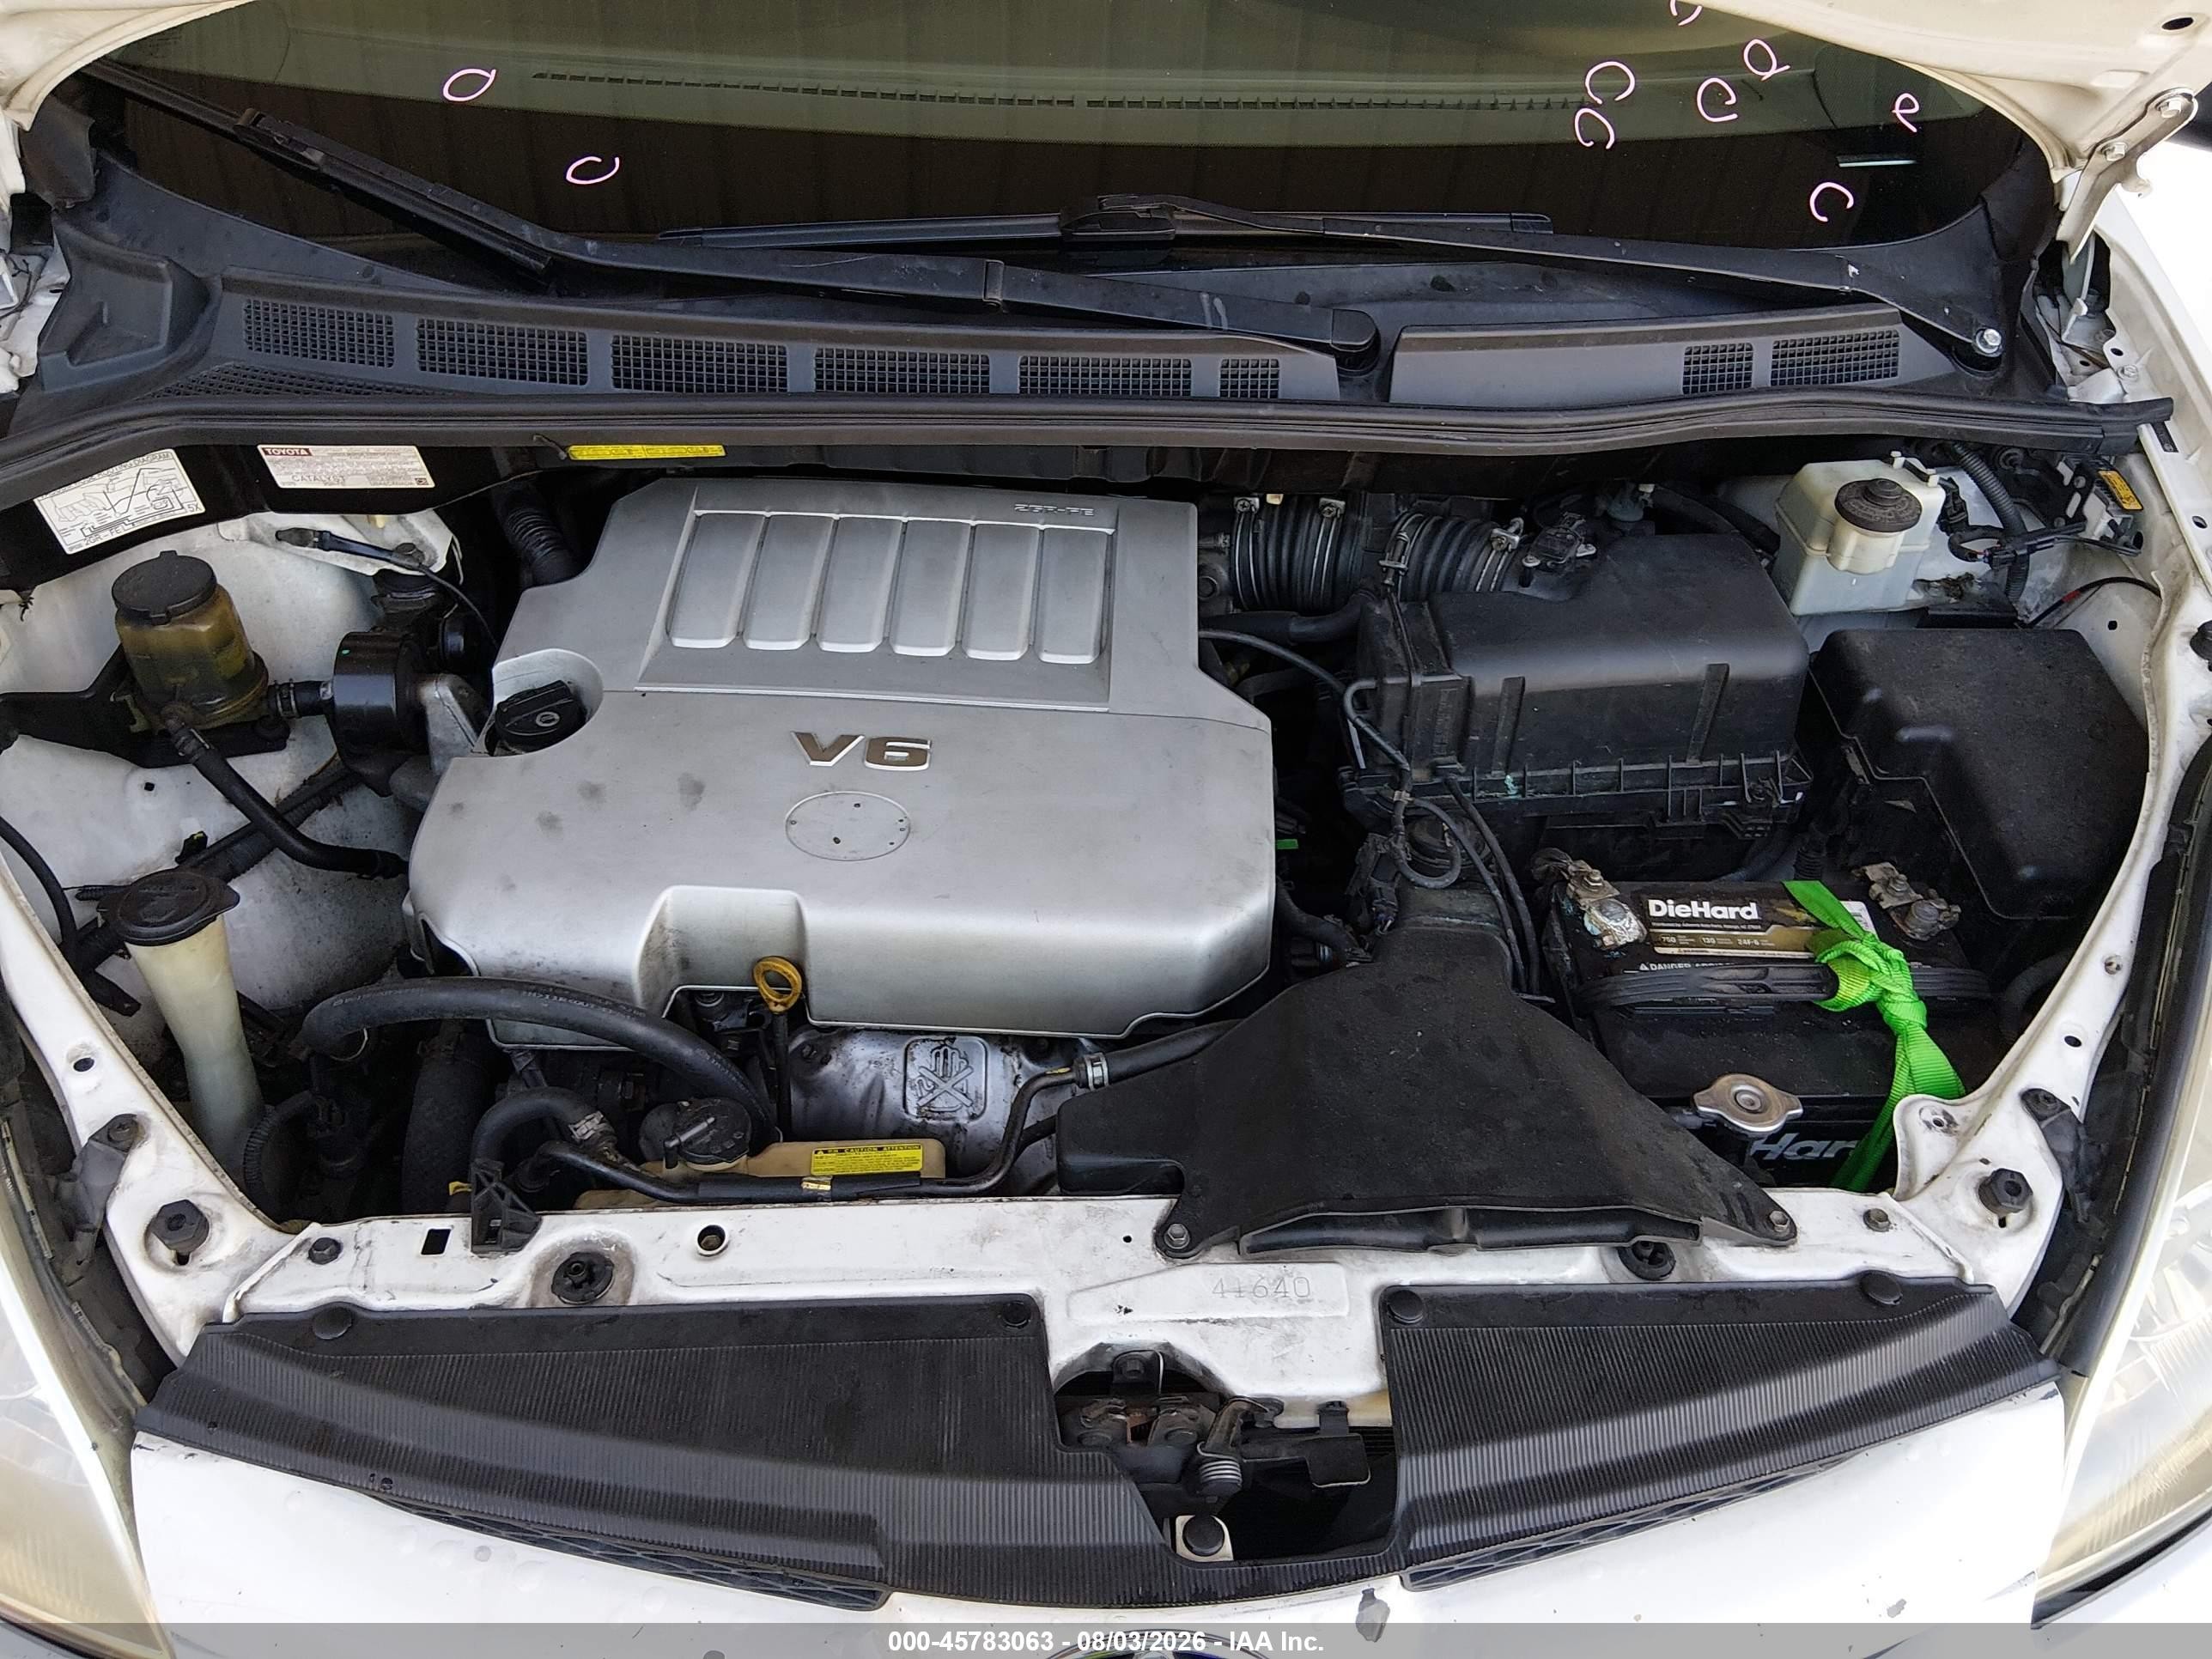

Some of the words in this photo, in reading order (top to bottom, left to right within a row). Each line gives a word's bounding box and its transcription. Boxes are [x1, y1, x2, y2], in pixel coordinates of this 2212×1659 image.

[134, 453, 170, 467] DIAGRAM
[291, 474, 345, 483] CATALYST
[185, 502, 201, 513] 5X
[791, 731, 932, 771] V6
[1649, 899, 1759, 920] DieHard
[1750, 1133, 1859, 1159] Har
